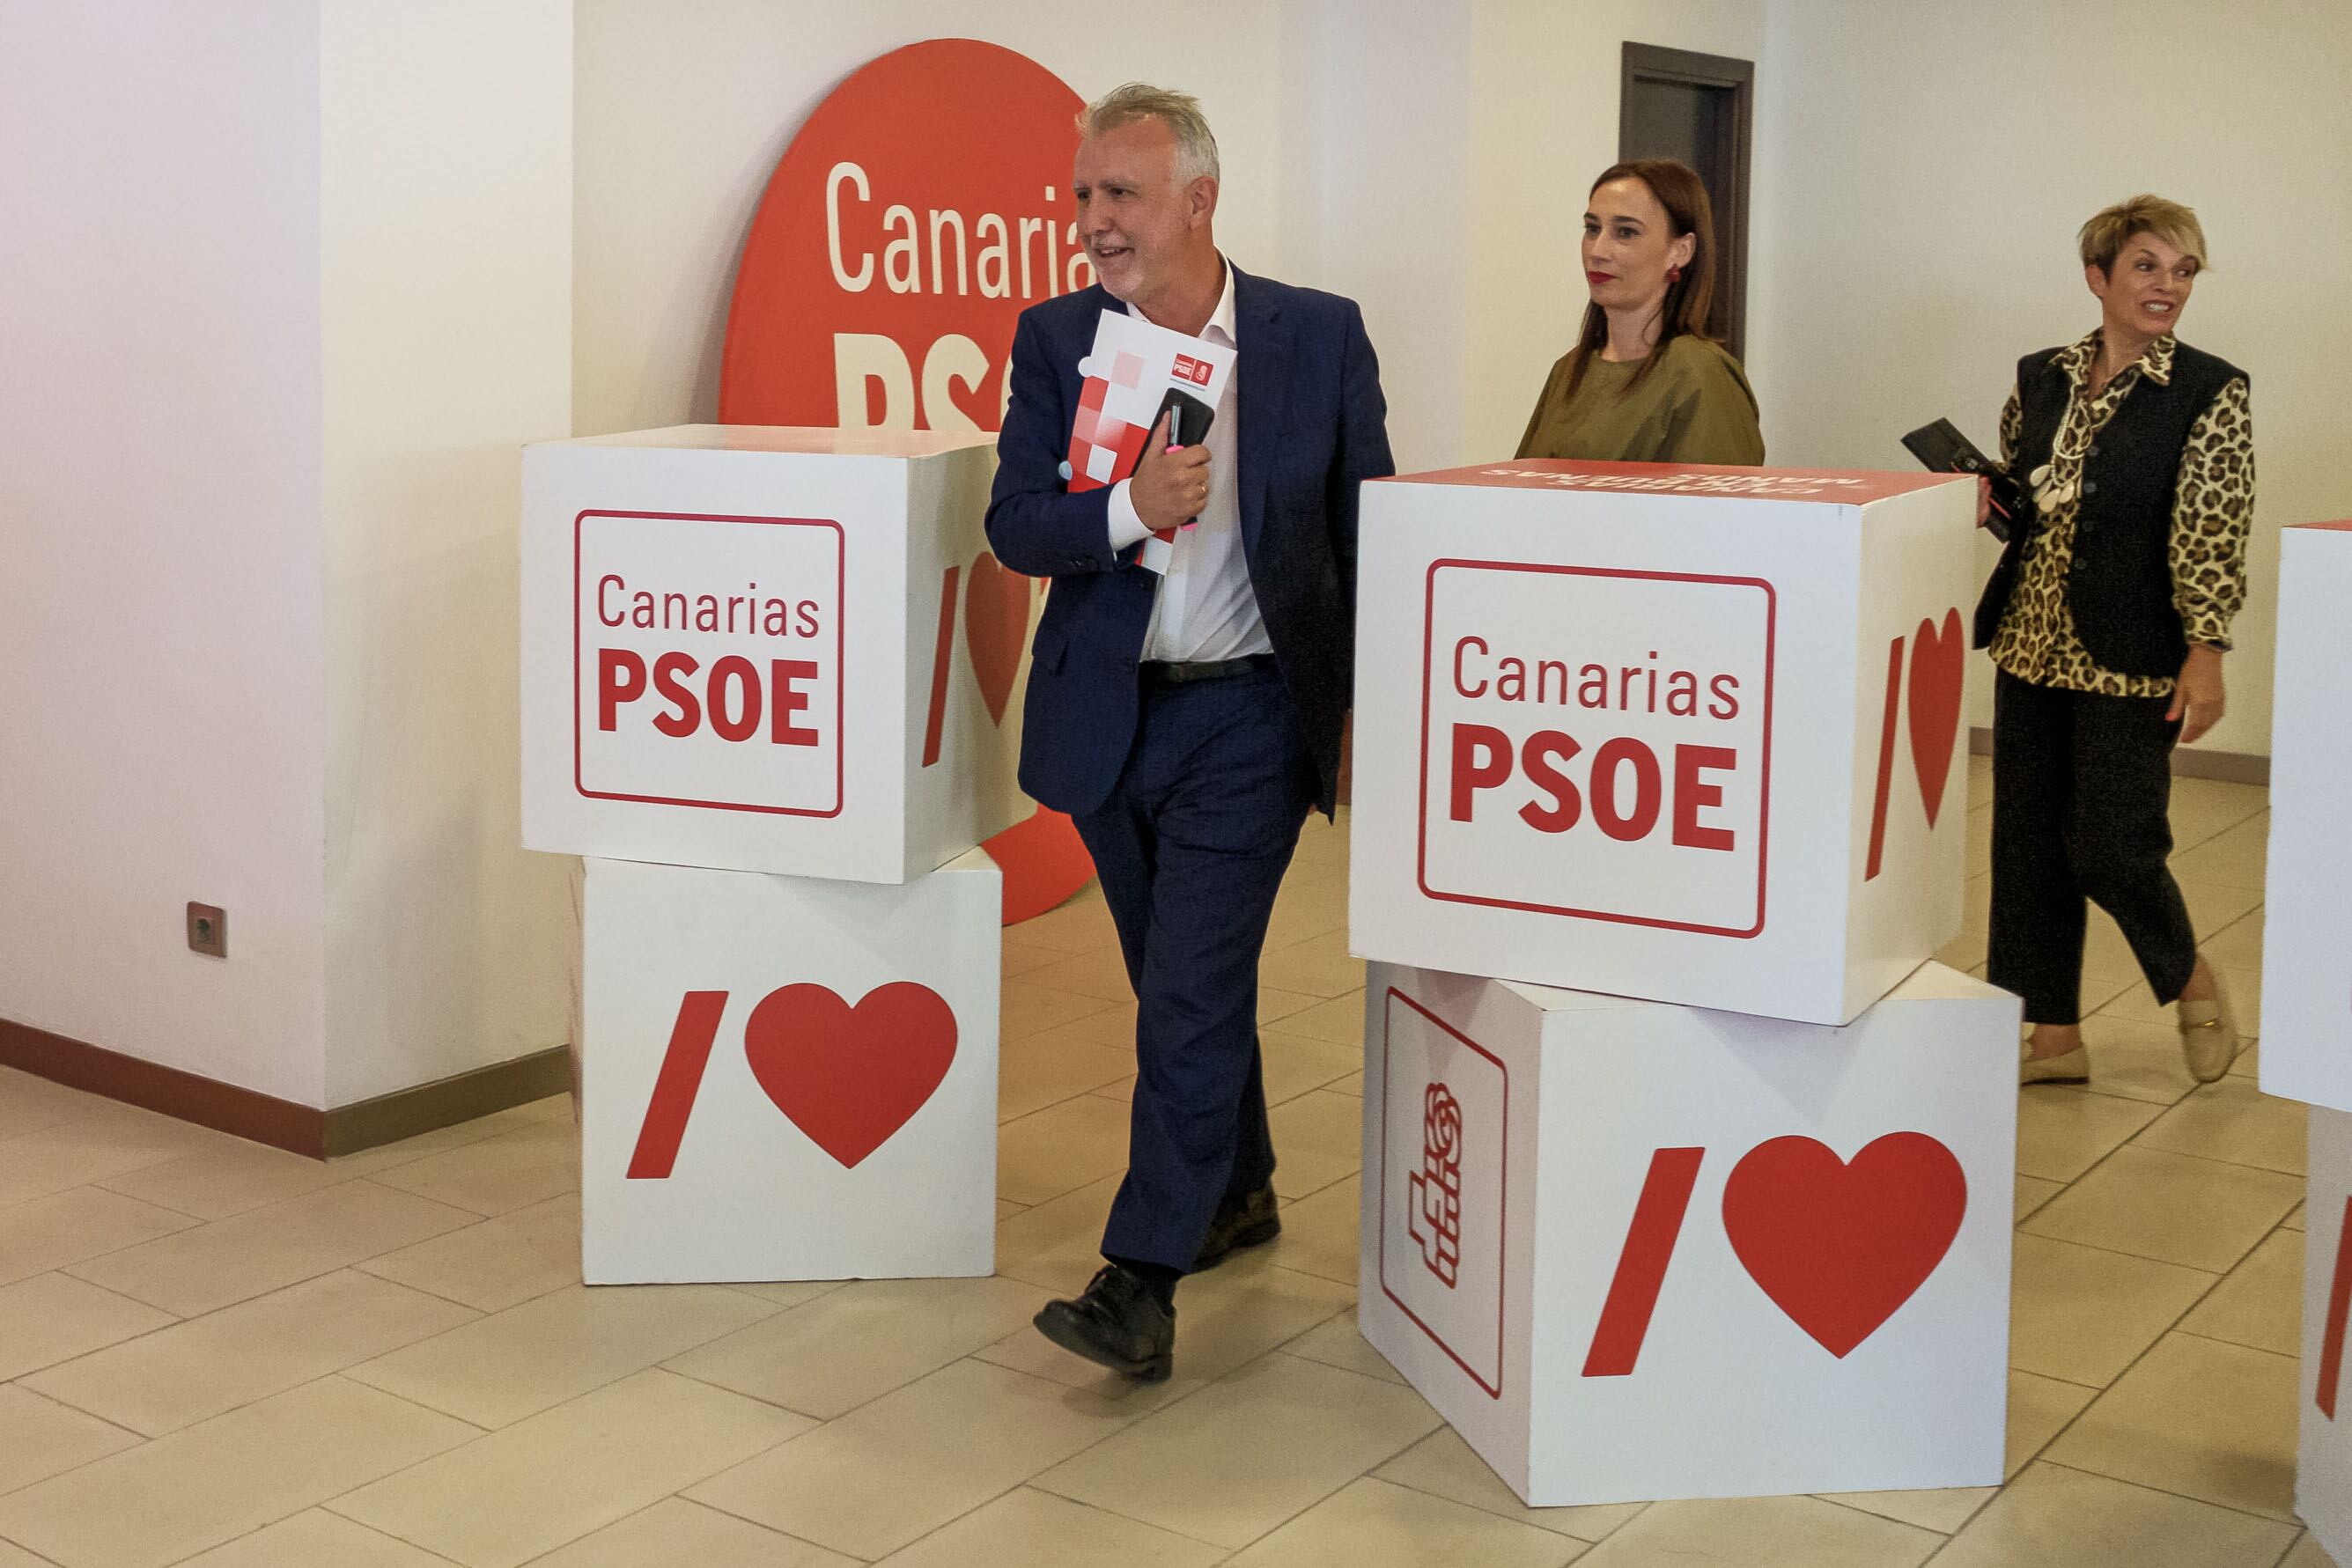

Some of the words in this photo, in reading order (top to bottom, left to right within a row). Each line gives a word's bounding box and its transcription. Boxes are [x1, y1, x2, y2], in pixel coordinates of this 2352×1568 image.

[826, 162, 1098, 300] Canaria
[1480, 469, 1690, 484] BUENAS
[1547, 480, 1823, 494] CANARIAS
[1672, 474, 1863, 484] MANOS
[599, 574, 819, 638] Canarias
[598, 648, 818, 747] PSOE
[1454, 636, 1739, 721] Canarias
[1449, 722, 1736, 851] PSOE
